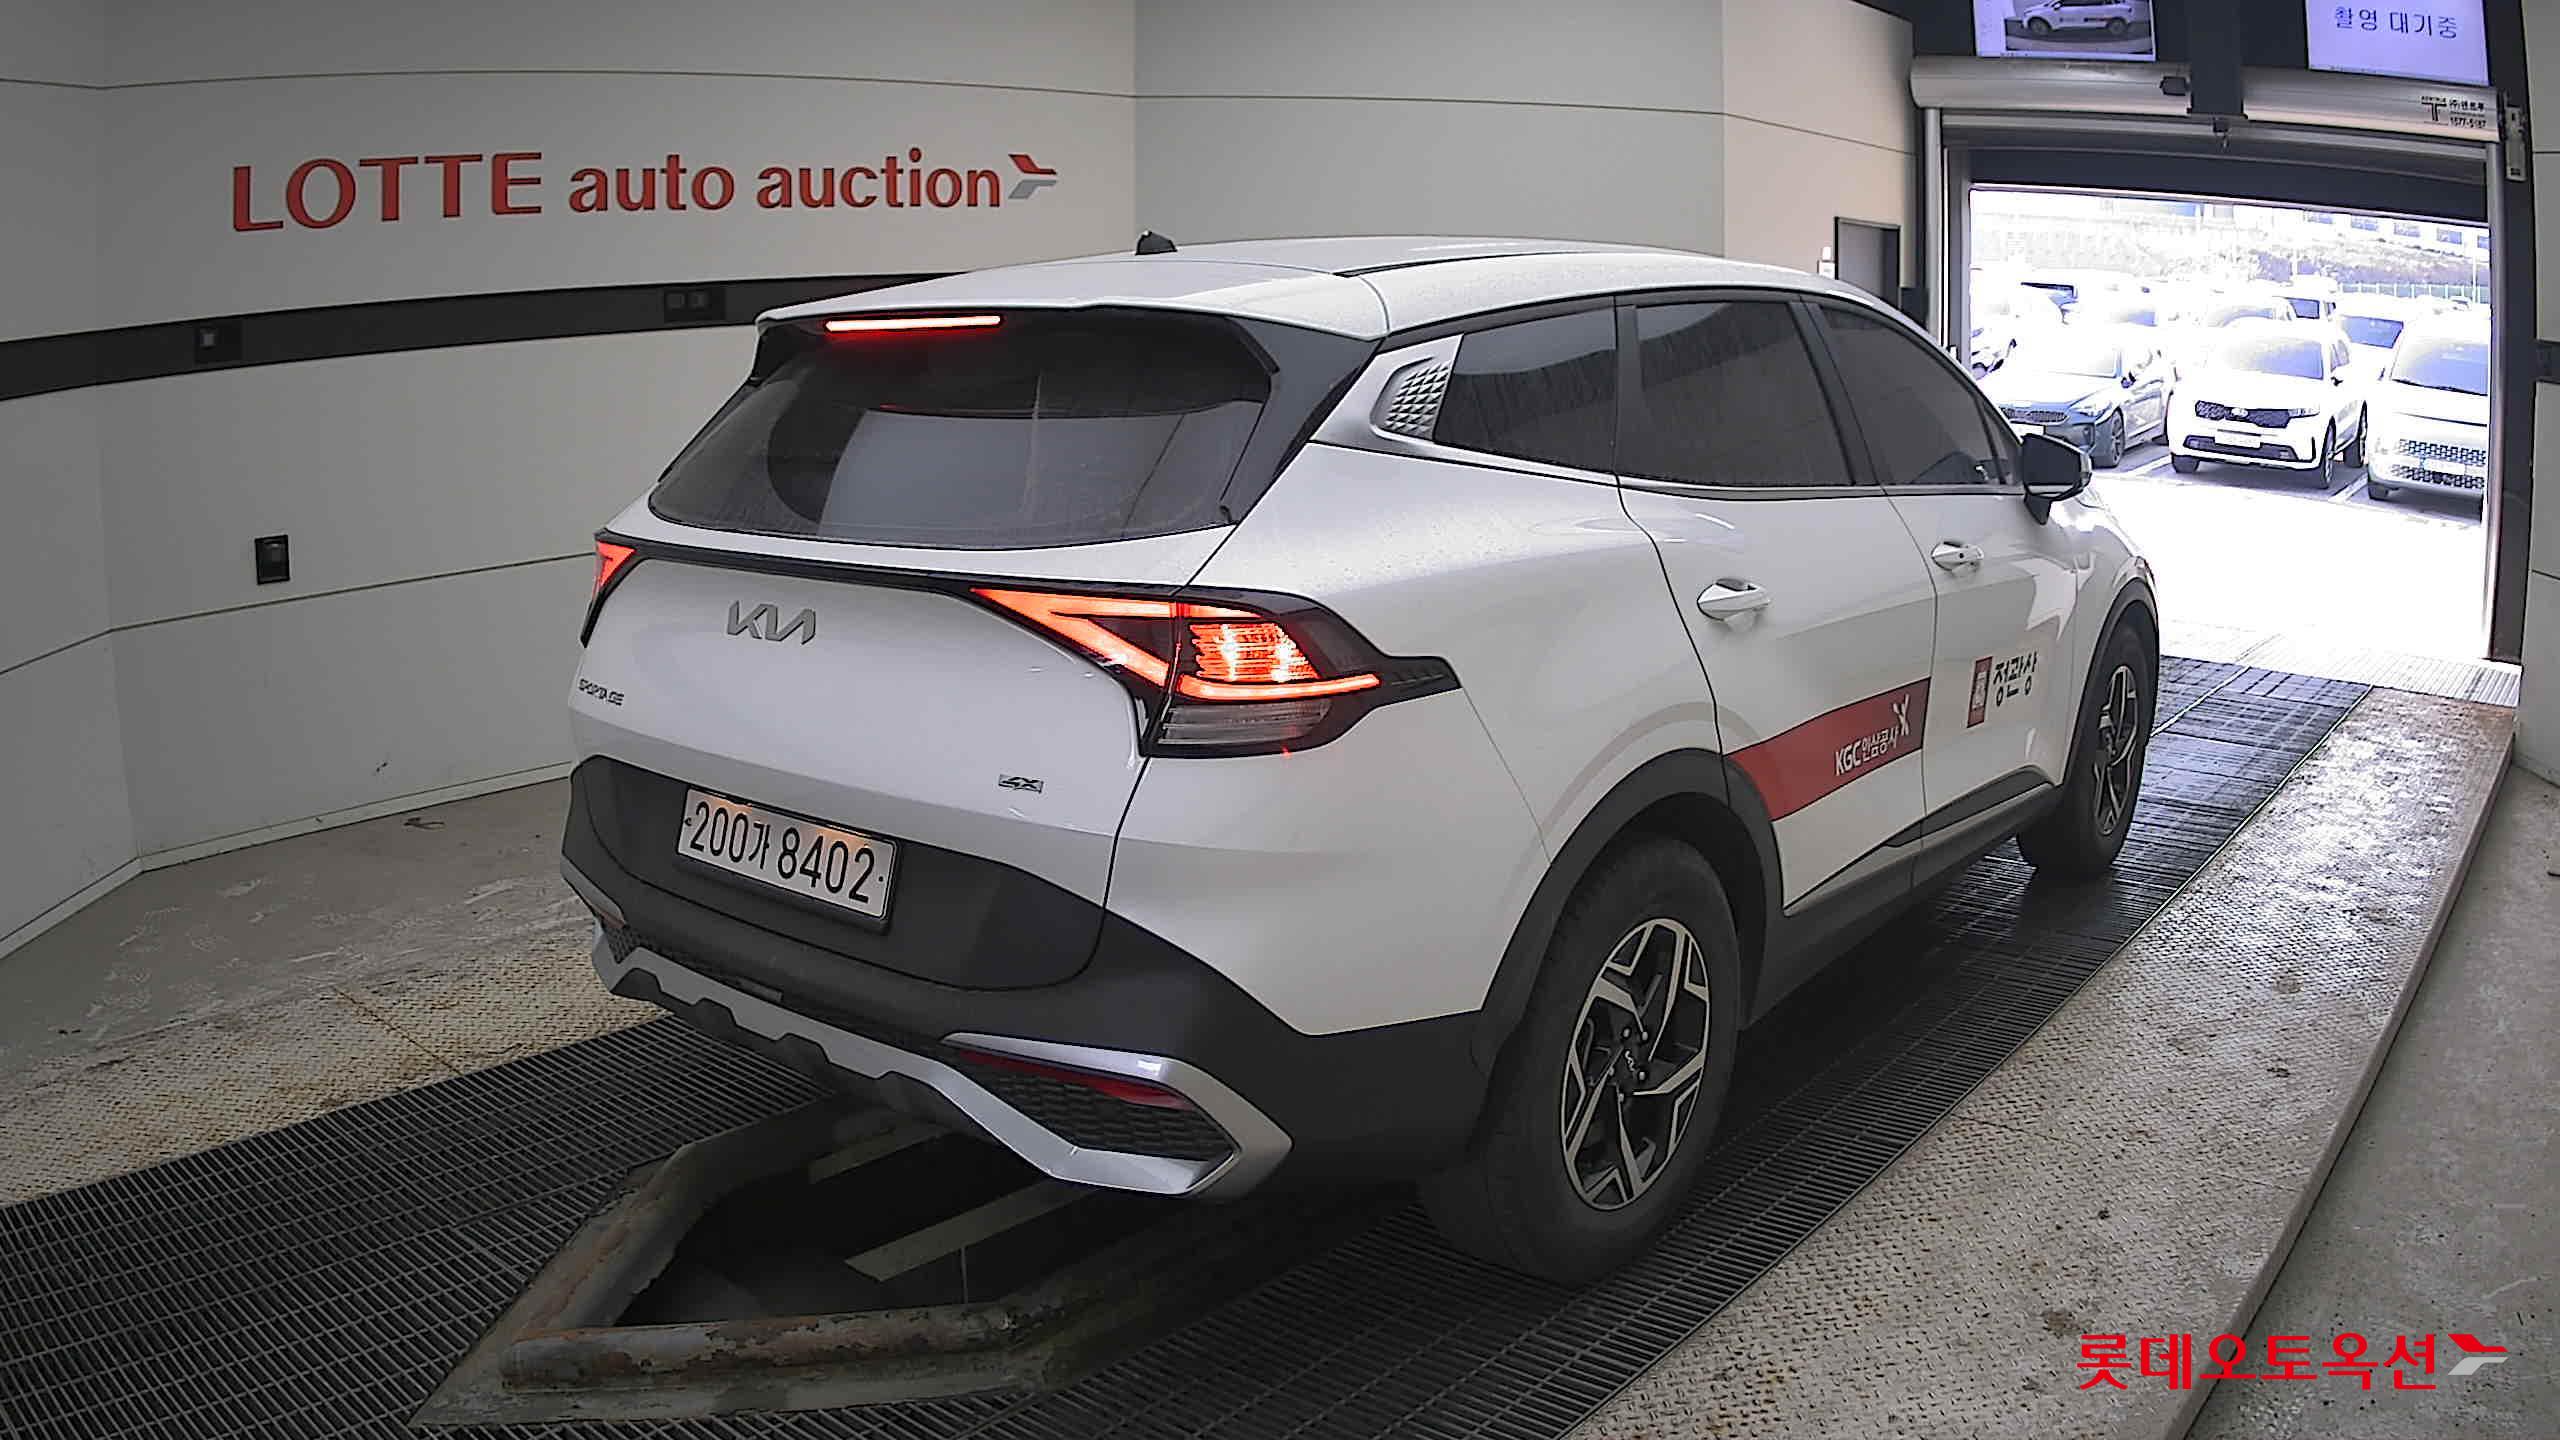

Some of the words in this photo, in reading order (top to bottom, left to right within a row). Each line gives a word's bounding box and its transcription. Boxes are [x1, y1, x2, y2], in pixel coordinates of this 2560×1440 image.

[2389, 11, 2457, 39] 대기중
[233, 151, 542, 232] LOTTE
[568, 153, 735, 213] auto
[756, 147, 1002, 210] auction
[726, 600, 817, 645] KIA
[690, 801, 771, 870] 200가
[777, 827, 876, 904] 8402
